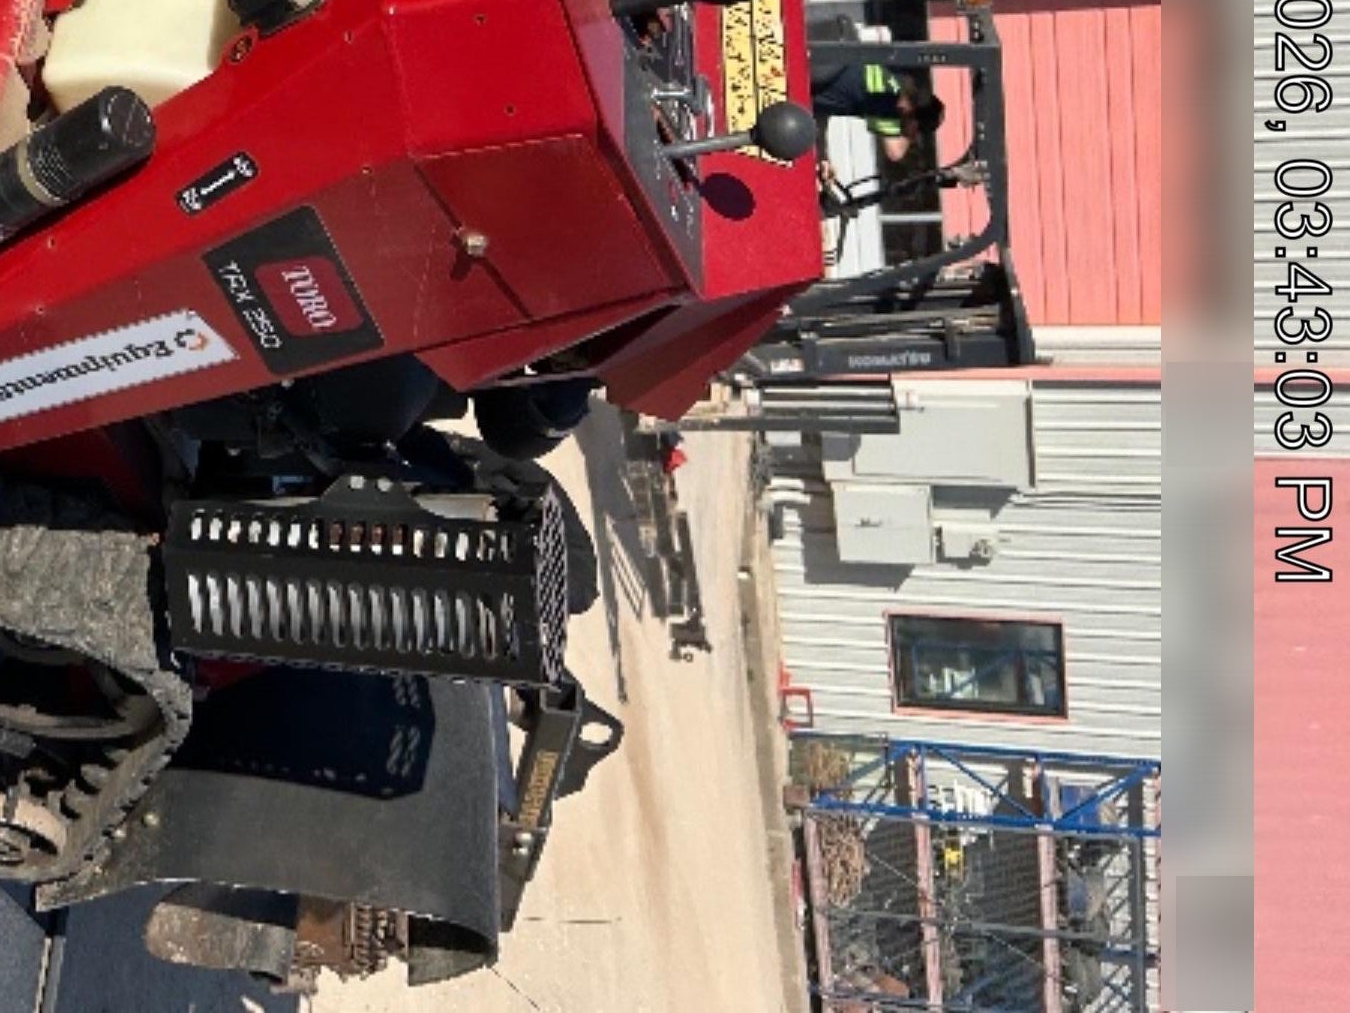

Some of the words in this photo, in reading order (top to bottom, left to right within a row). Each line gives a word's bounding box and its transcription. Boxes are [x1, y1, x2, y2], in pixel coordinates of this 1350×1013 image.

[218, 260, 256, 303] TRX
[242, 307, 282, 349] 250
[281, 265, 338, 328] TORO
